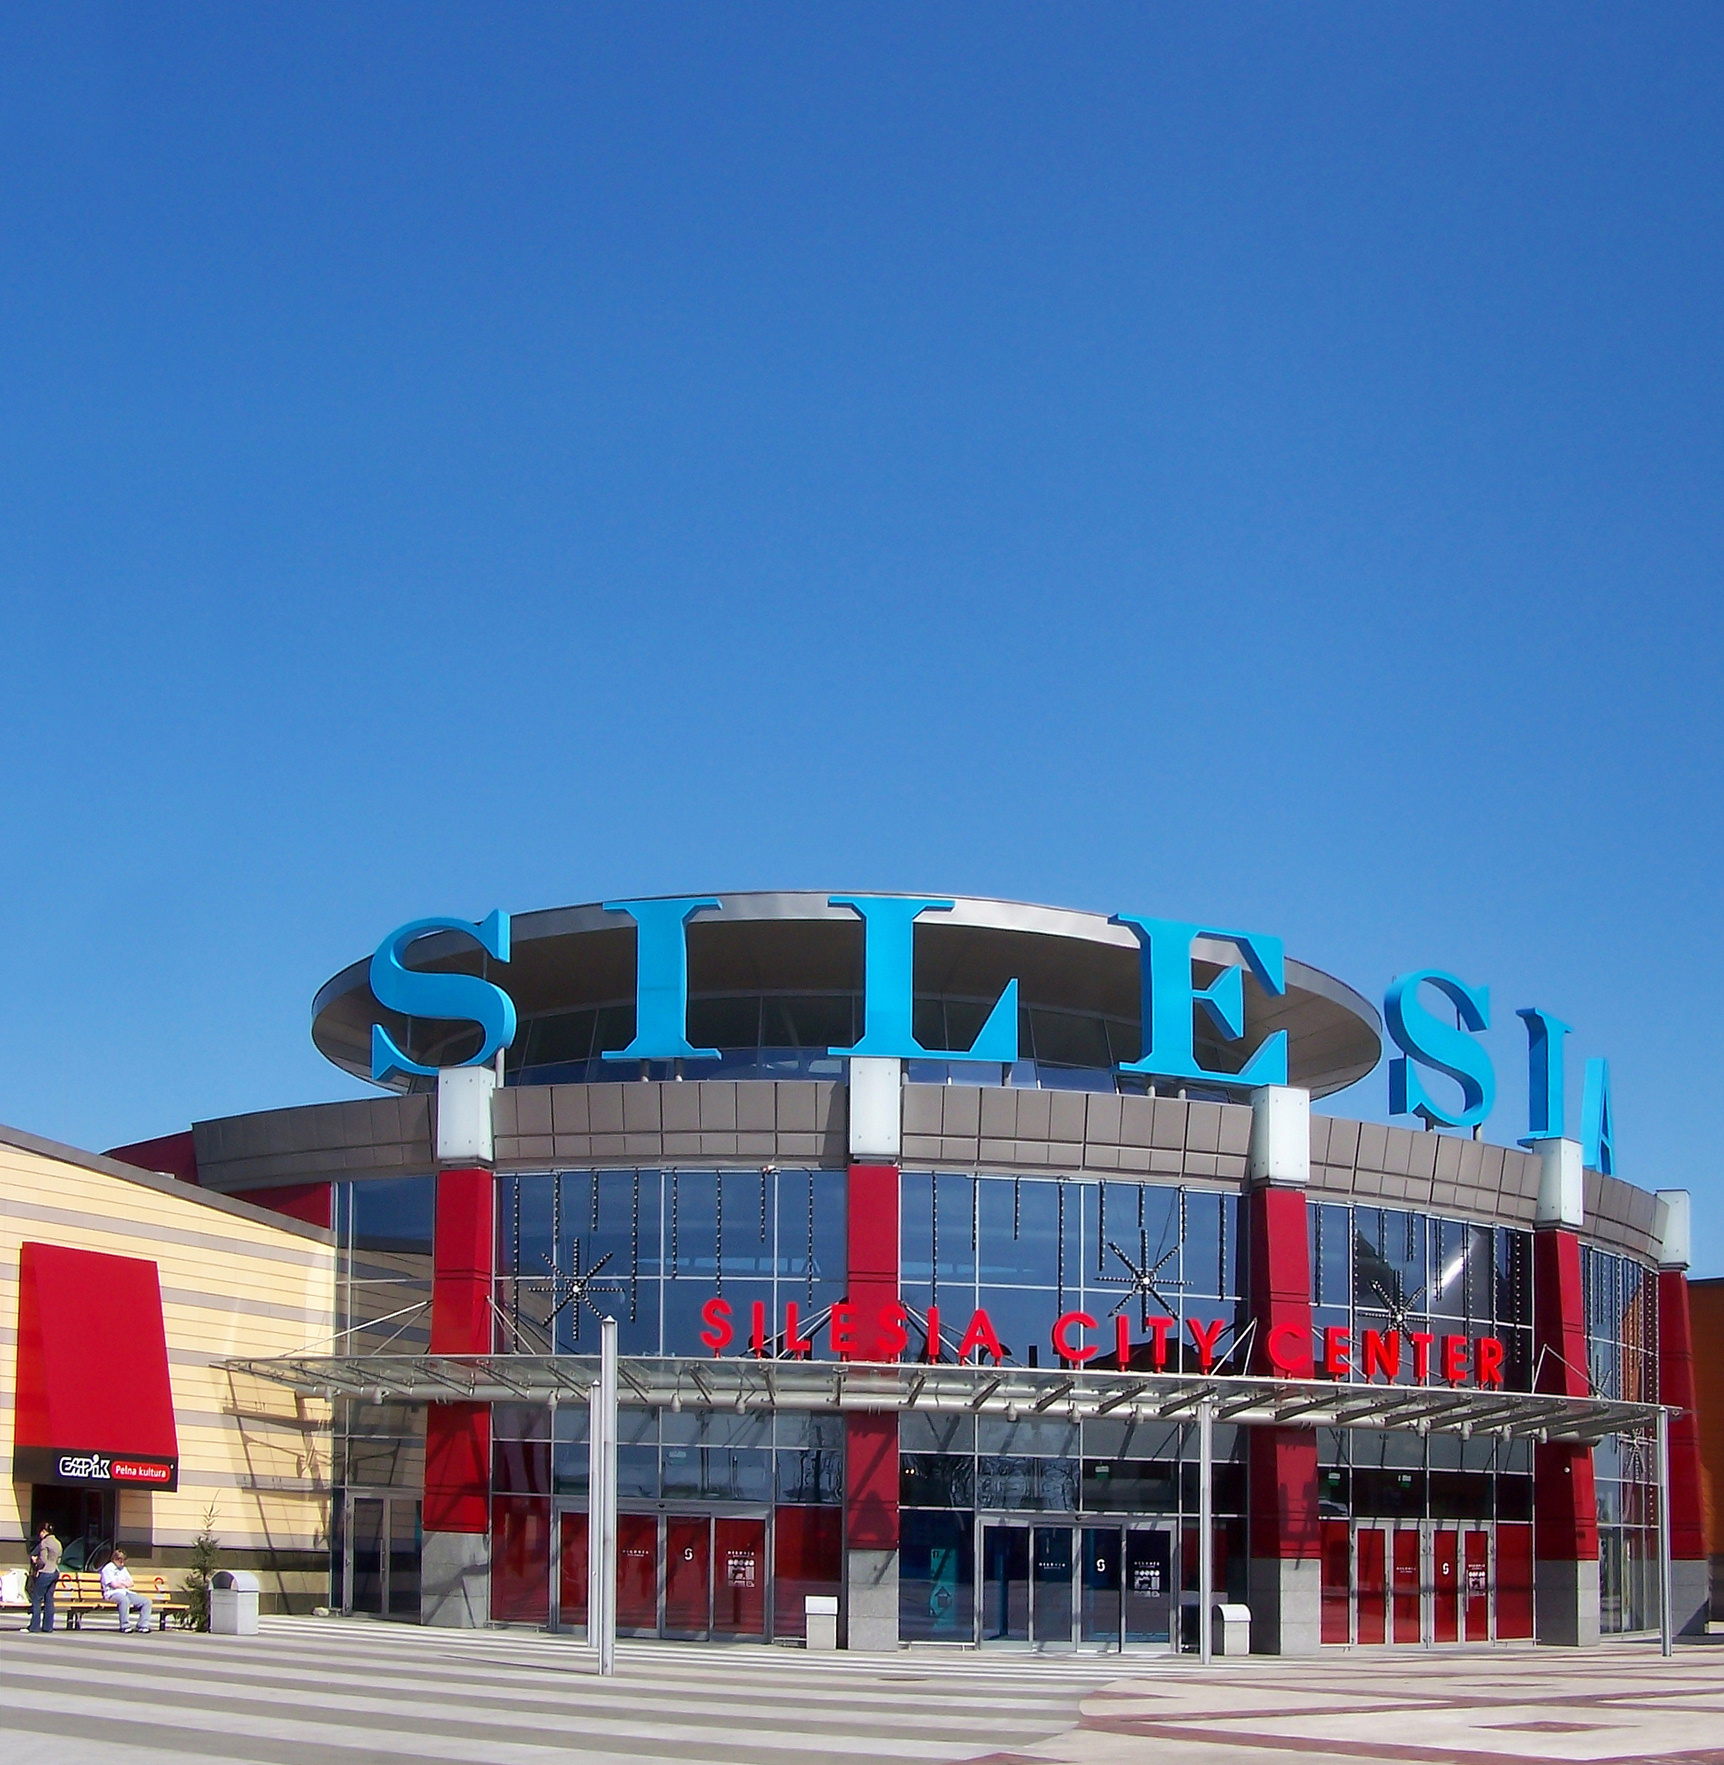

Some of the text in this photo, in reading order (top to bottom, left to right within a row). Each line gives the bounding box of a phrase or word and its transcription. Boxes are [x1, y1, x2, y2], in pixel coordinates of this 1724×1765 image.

[369, 896, 1617, 1176] SILESIA
[700, 1298, 1504, 1384] SILESIA CITY CENTER
[138, 1466, 167, 1478] kultura
